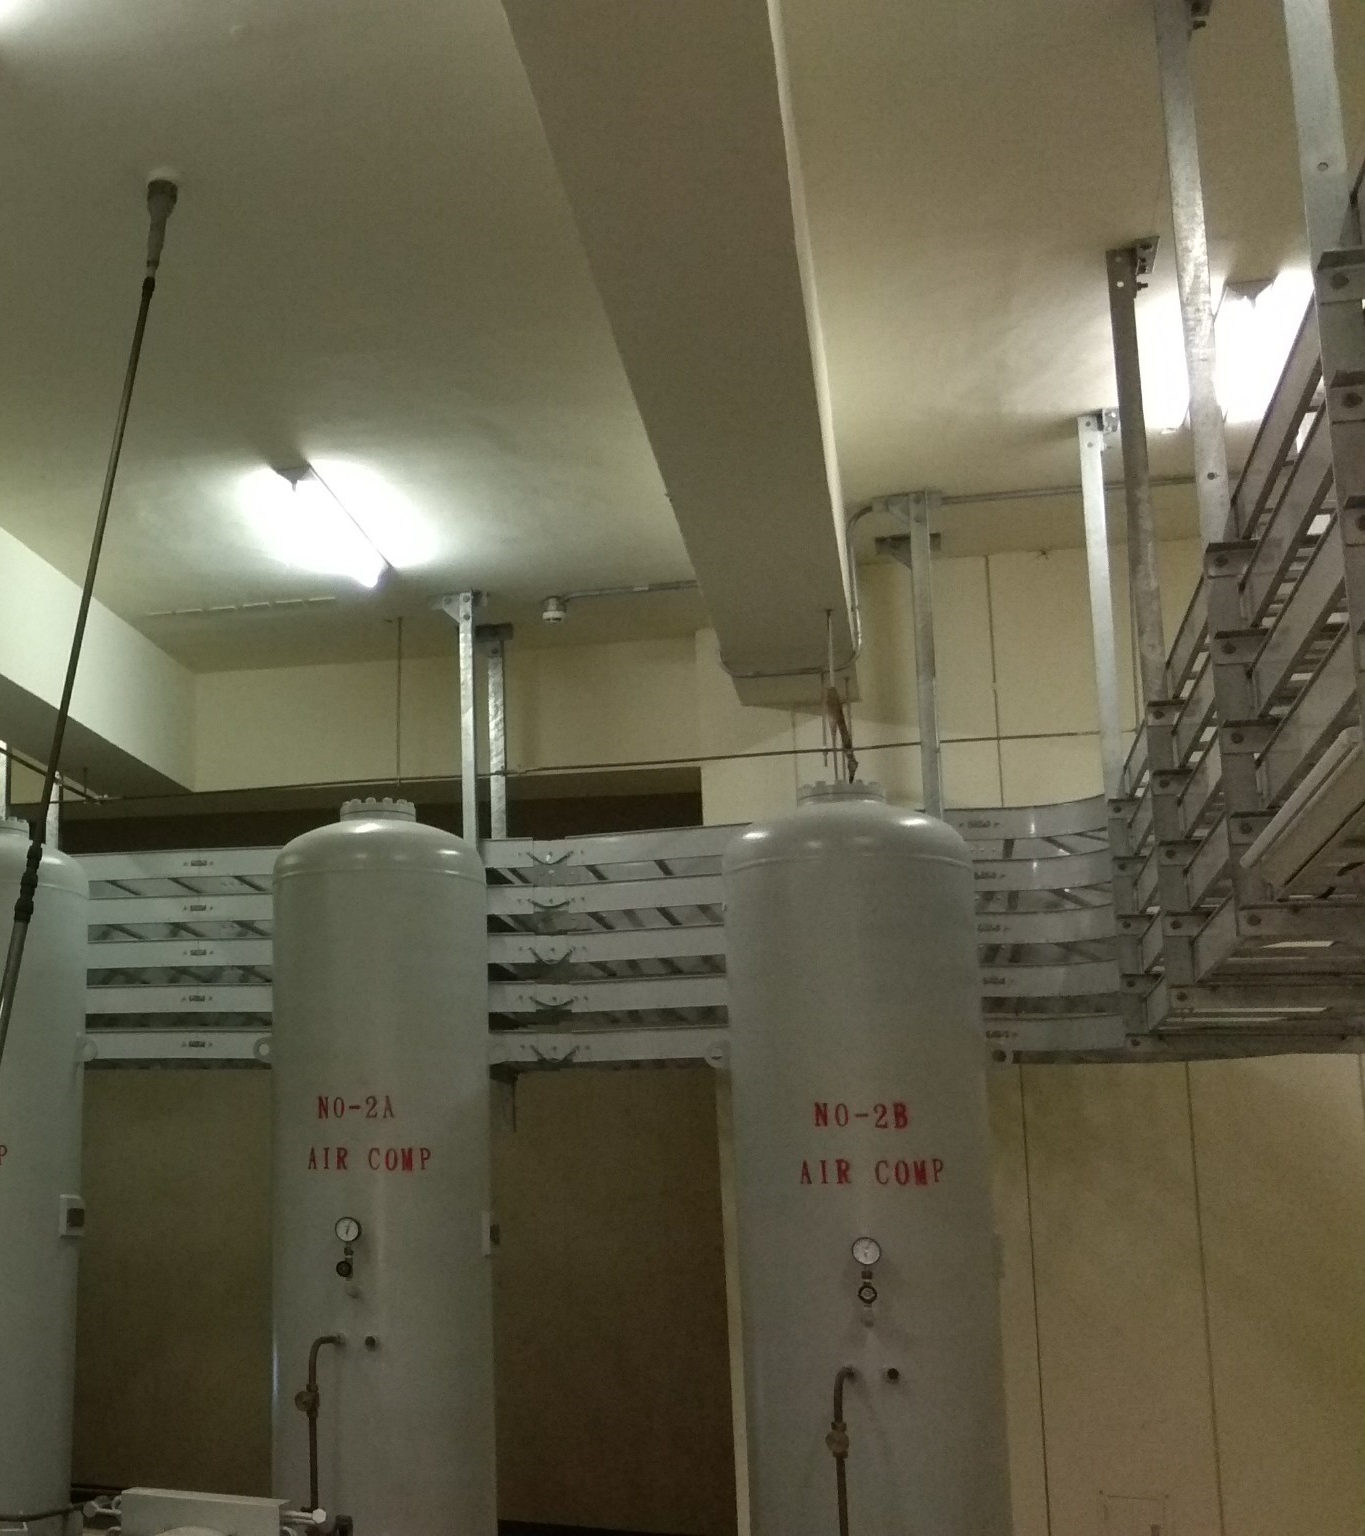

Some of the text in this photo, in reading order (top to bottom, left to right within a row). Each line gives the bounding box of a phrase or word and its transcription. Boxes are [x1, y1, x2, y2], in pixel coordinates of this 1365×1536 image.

[318, 1096, 394, 1119] NO-2A
[814, 1102, 908, 1129] NO-2B
[308, 1147, 431, 1171] AIR COMP
[800, 1158, 944, 1185] AIR COMP
